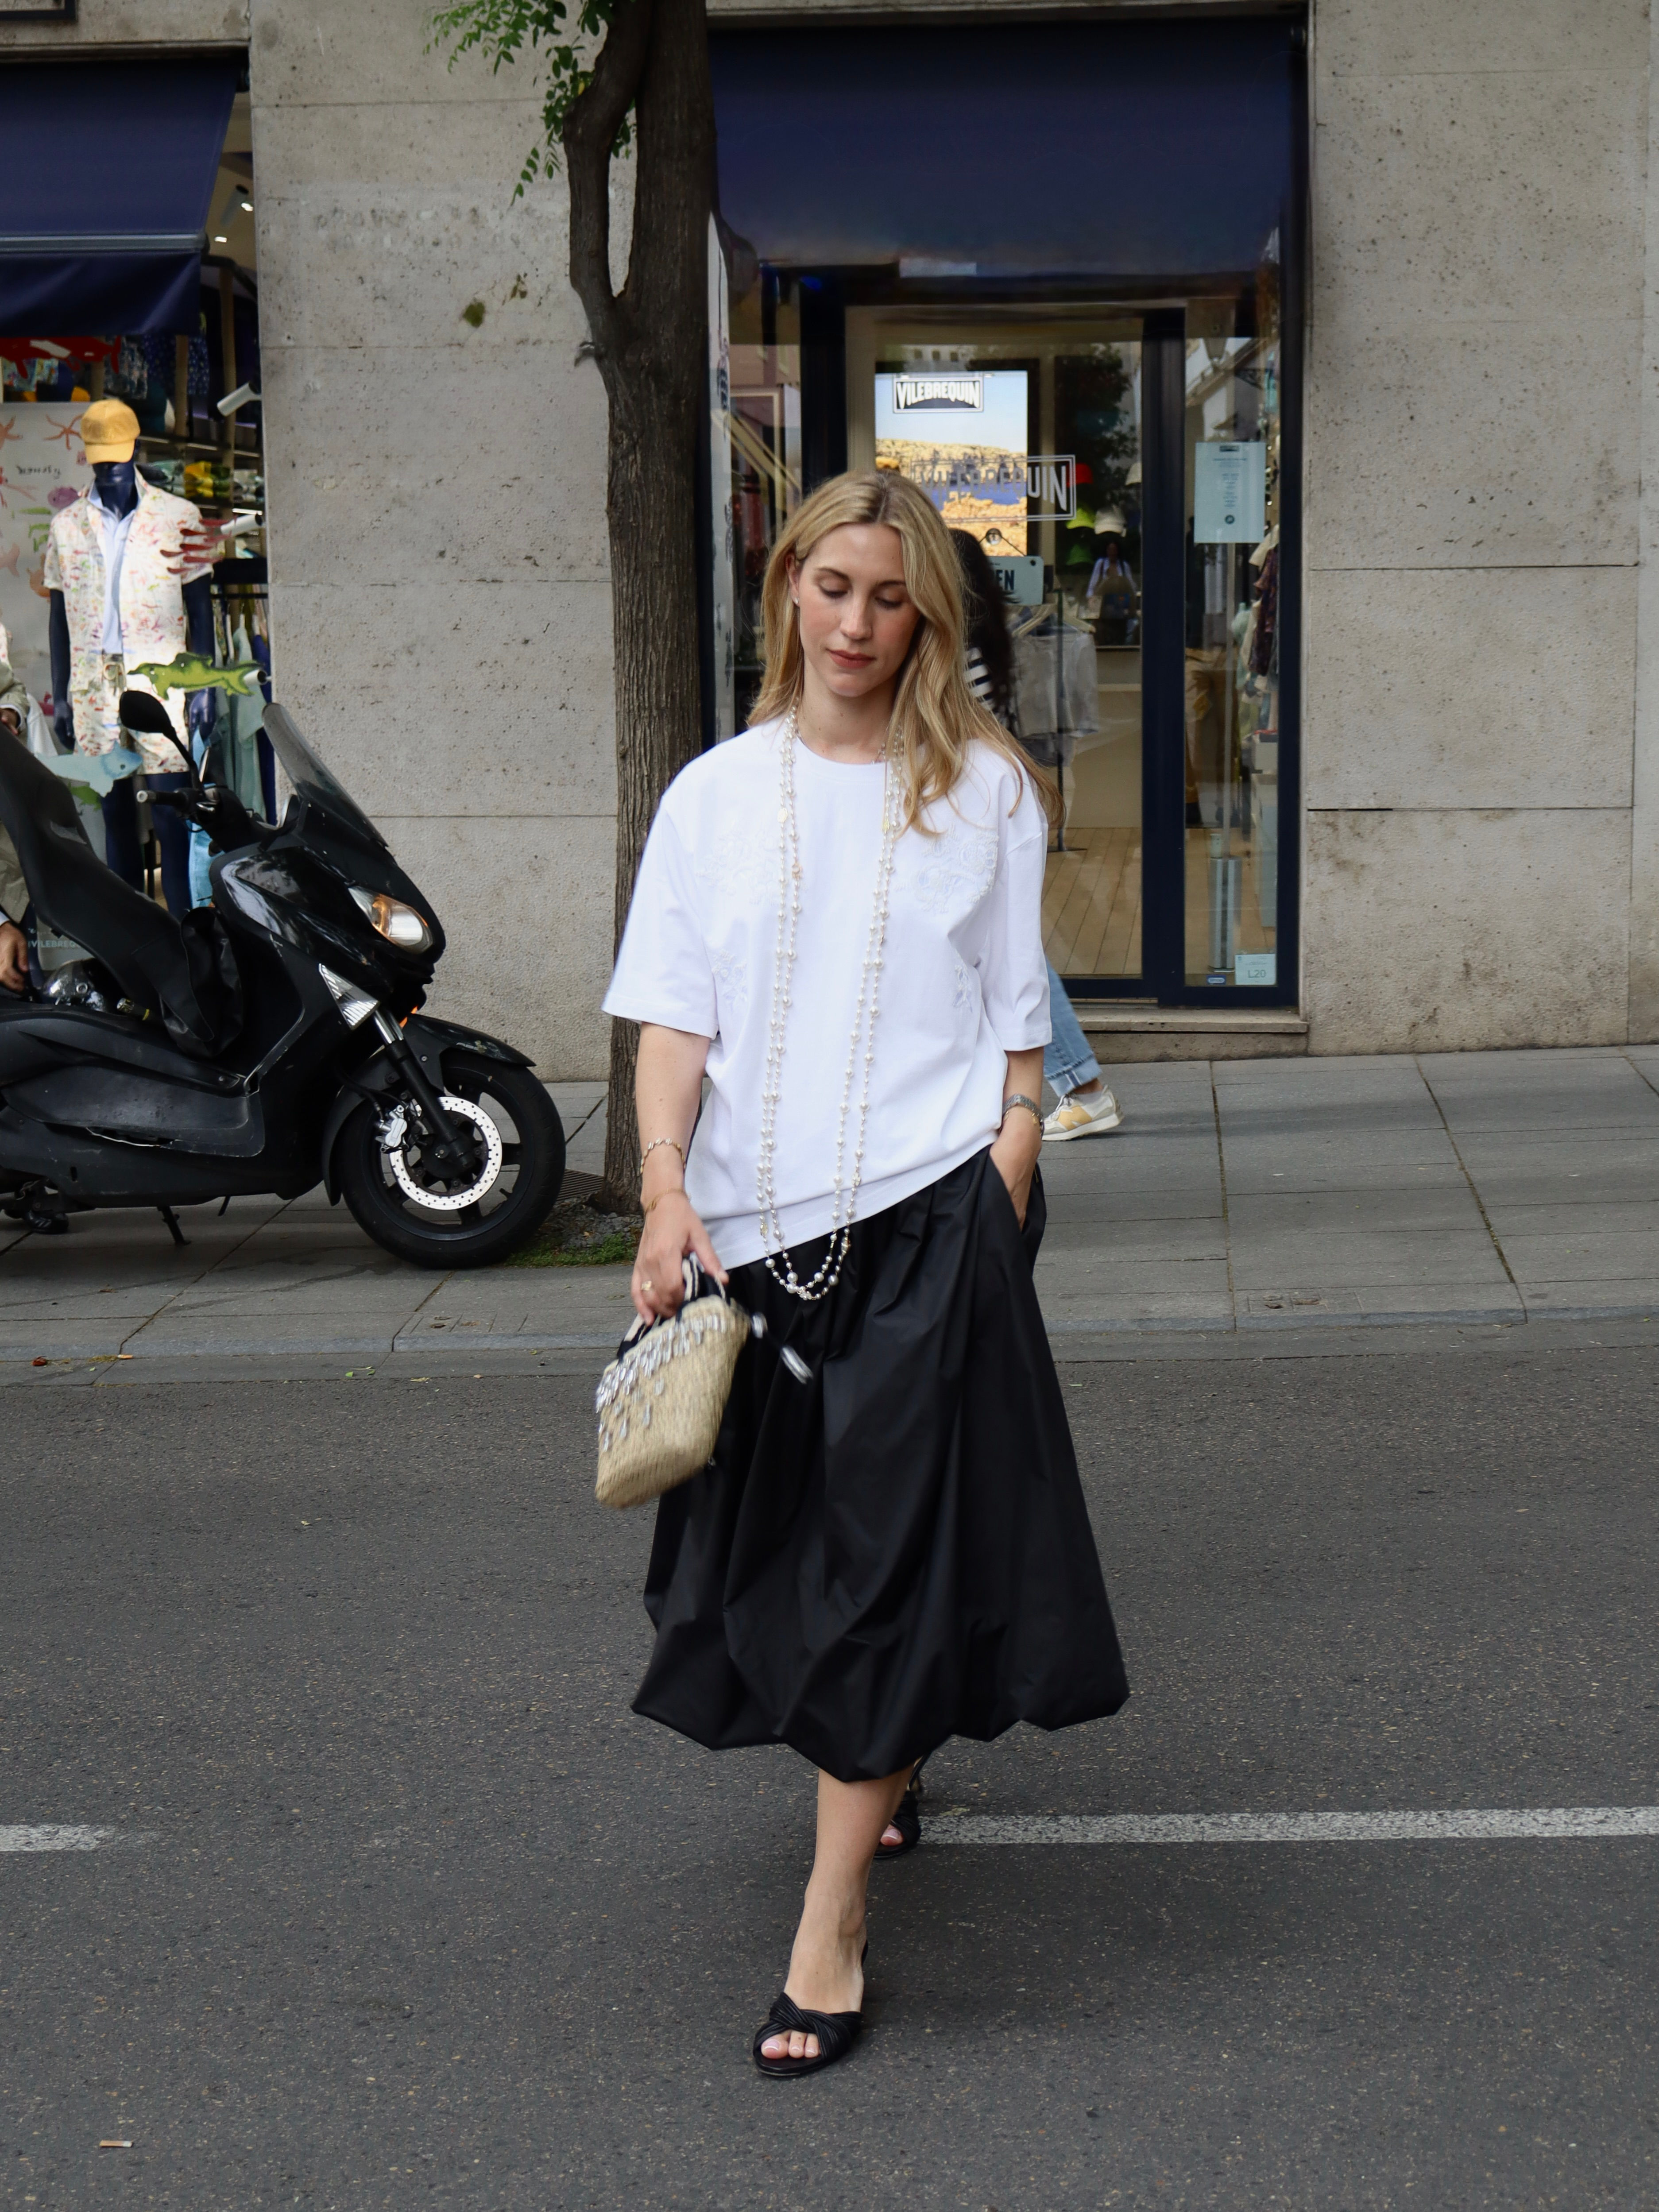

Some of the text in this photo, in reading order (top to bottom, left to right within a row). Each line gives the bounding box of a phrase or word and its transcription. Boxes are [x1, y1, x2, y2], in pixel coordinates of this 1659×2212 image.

[897, 381, 979, 410] VILEBREQUIN
[995, 569, 1015, 590] EN
[1248, 970, 1267, 978] L20
